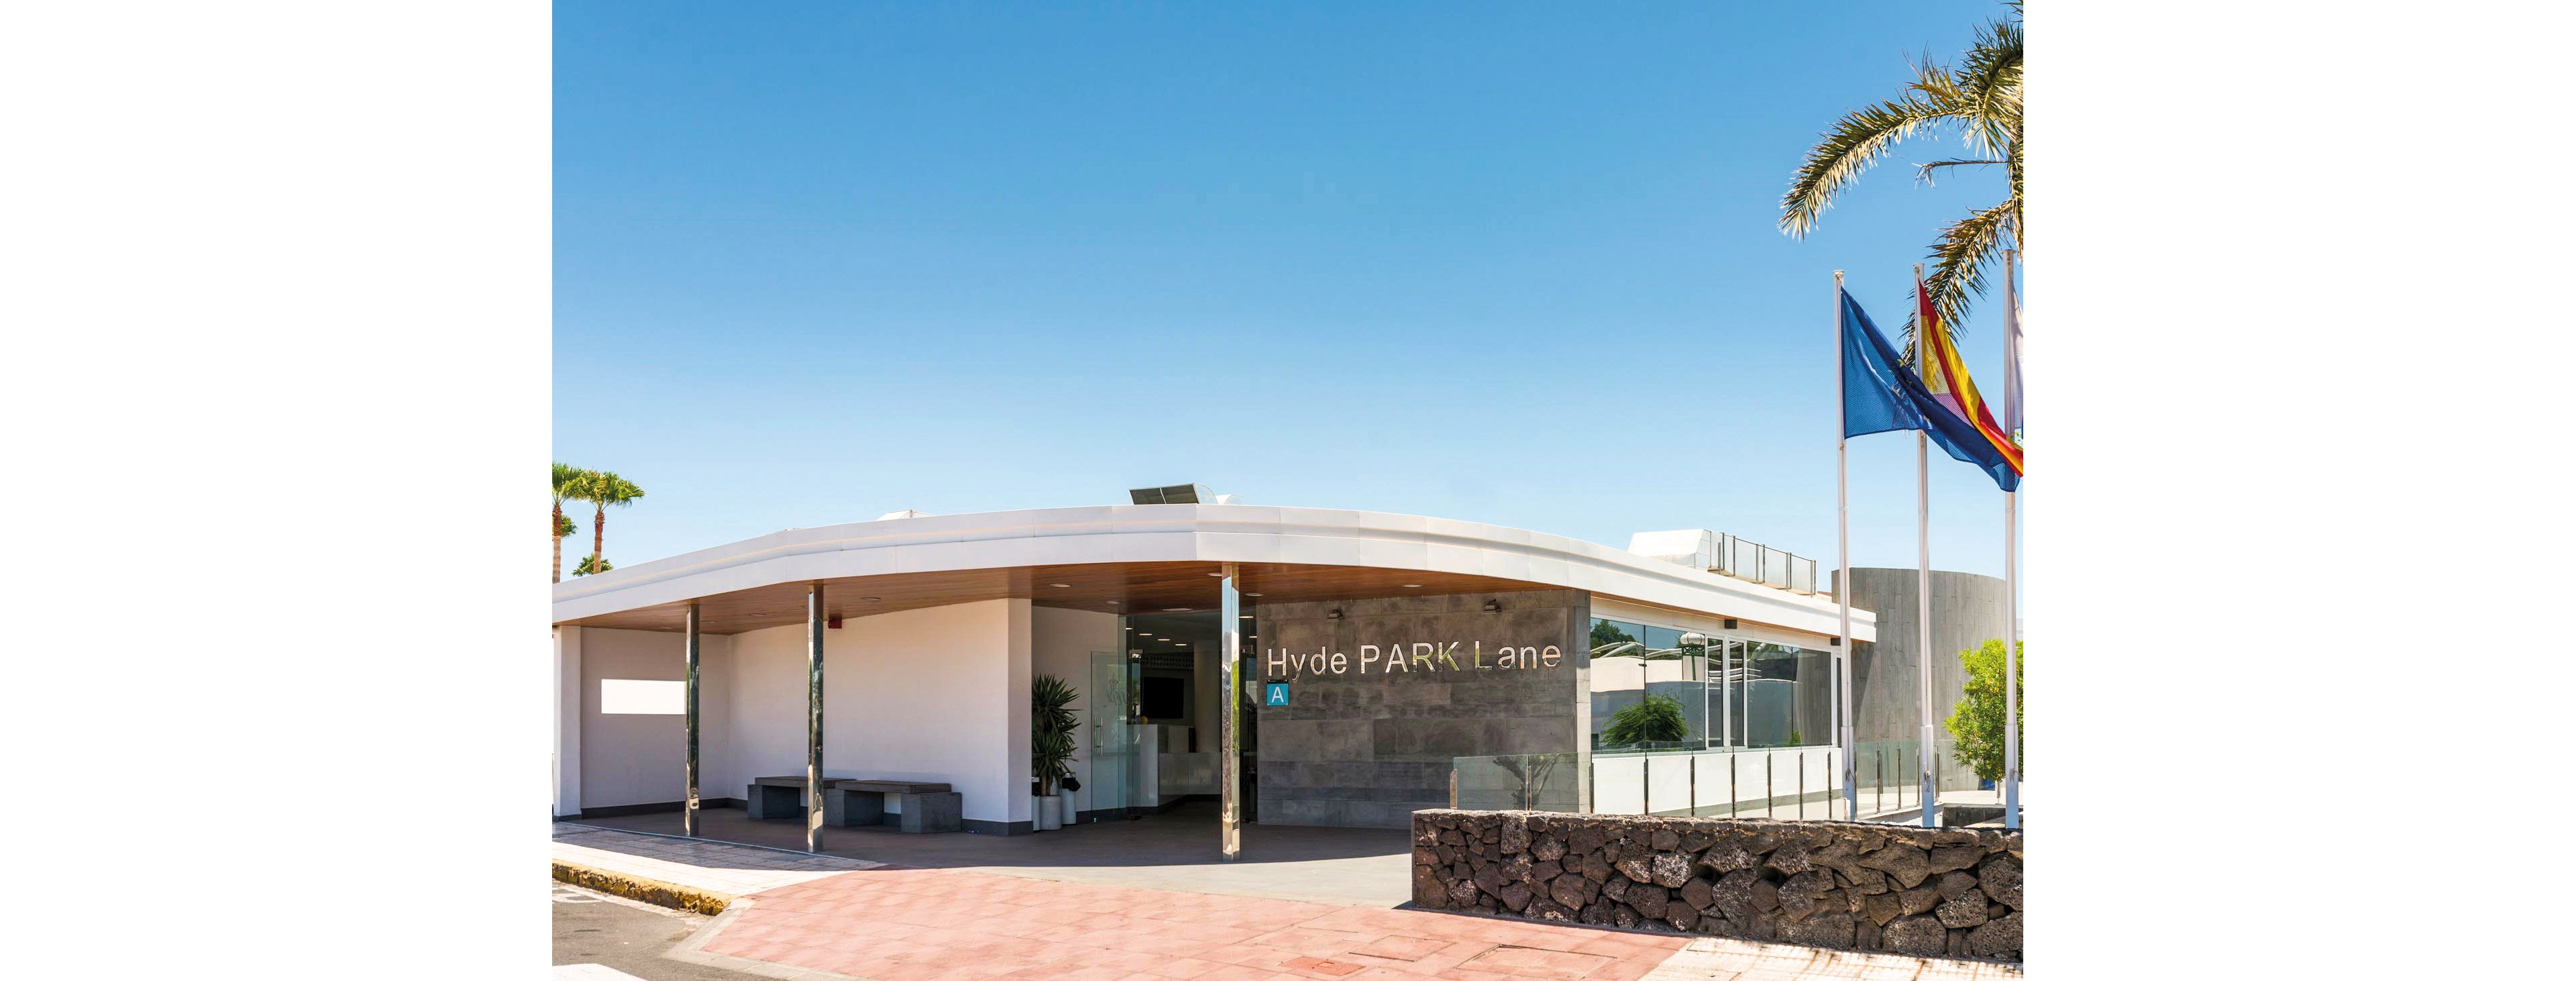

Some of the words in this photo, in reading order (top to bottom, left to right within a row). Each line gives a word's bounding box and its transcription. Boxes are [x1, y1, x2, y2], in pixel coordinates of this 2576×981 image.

[1267, 646, 1347, 683] Hyde
[1360, 641, 1460, 674] PARK
[1474, 640, 1562, 670] Lane
[1271, 686, 1284, 703] A
